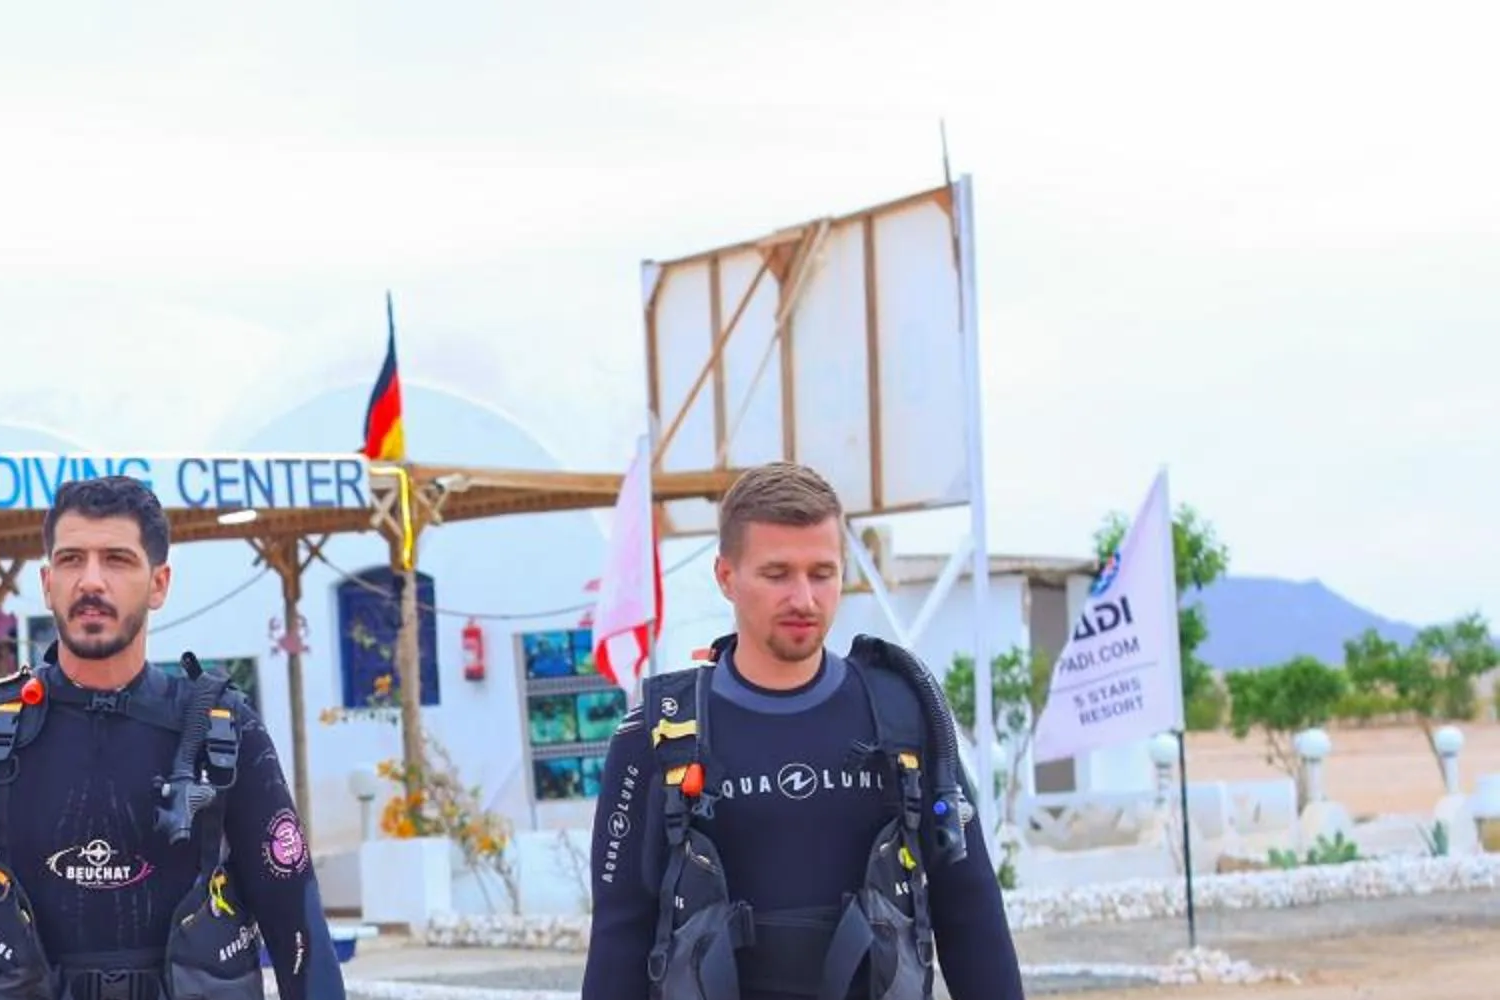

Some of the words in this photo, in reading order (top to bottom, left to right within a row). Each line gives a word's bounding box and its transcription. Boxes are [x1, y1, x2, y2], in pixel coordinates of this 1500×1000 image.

[177, 458, 367, 508] CENTER
[1073, 595, 1133, 642] ADI
[722, 775, 772, 799] QUA
[601, 841, 621, 883] AQUA
[617, 764, 640, 811] LUNG
[65, 865, 131, 880] BEUCHAT
